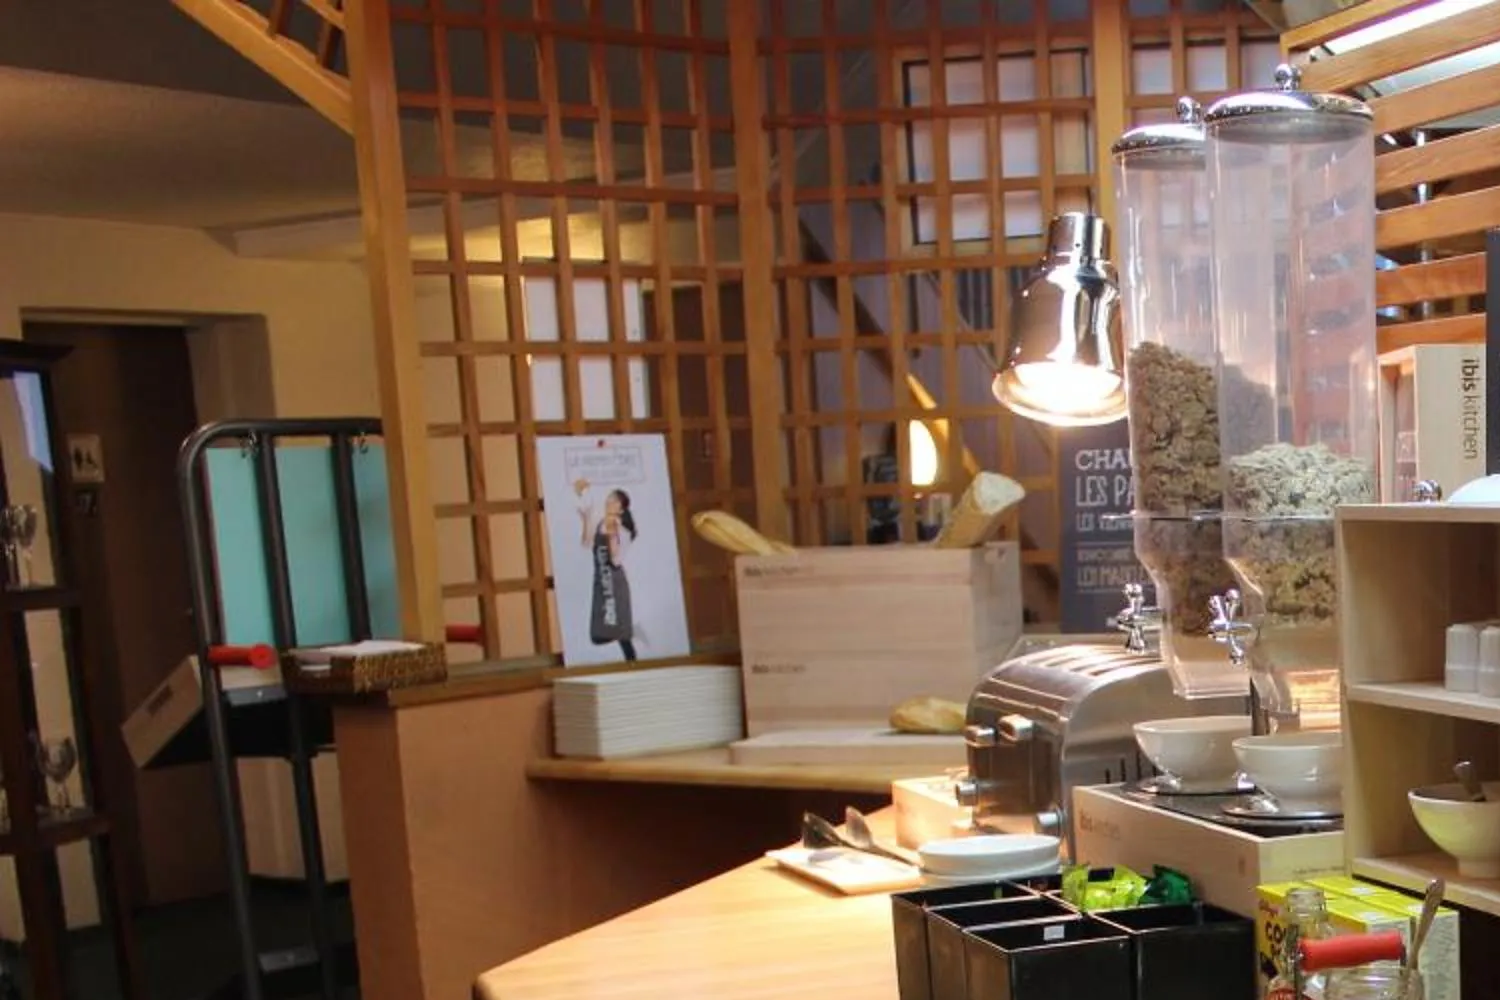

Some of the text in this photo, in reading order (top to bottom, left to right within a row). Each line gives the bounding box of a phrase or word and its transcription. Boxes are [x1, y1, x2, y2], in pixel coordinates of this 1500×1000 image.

[1461, 358, 1482, 461] ibis kitchen
[1075, 475, 1108, 508] LES
